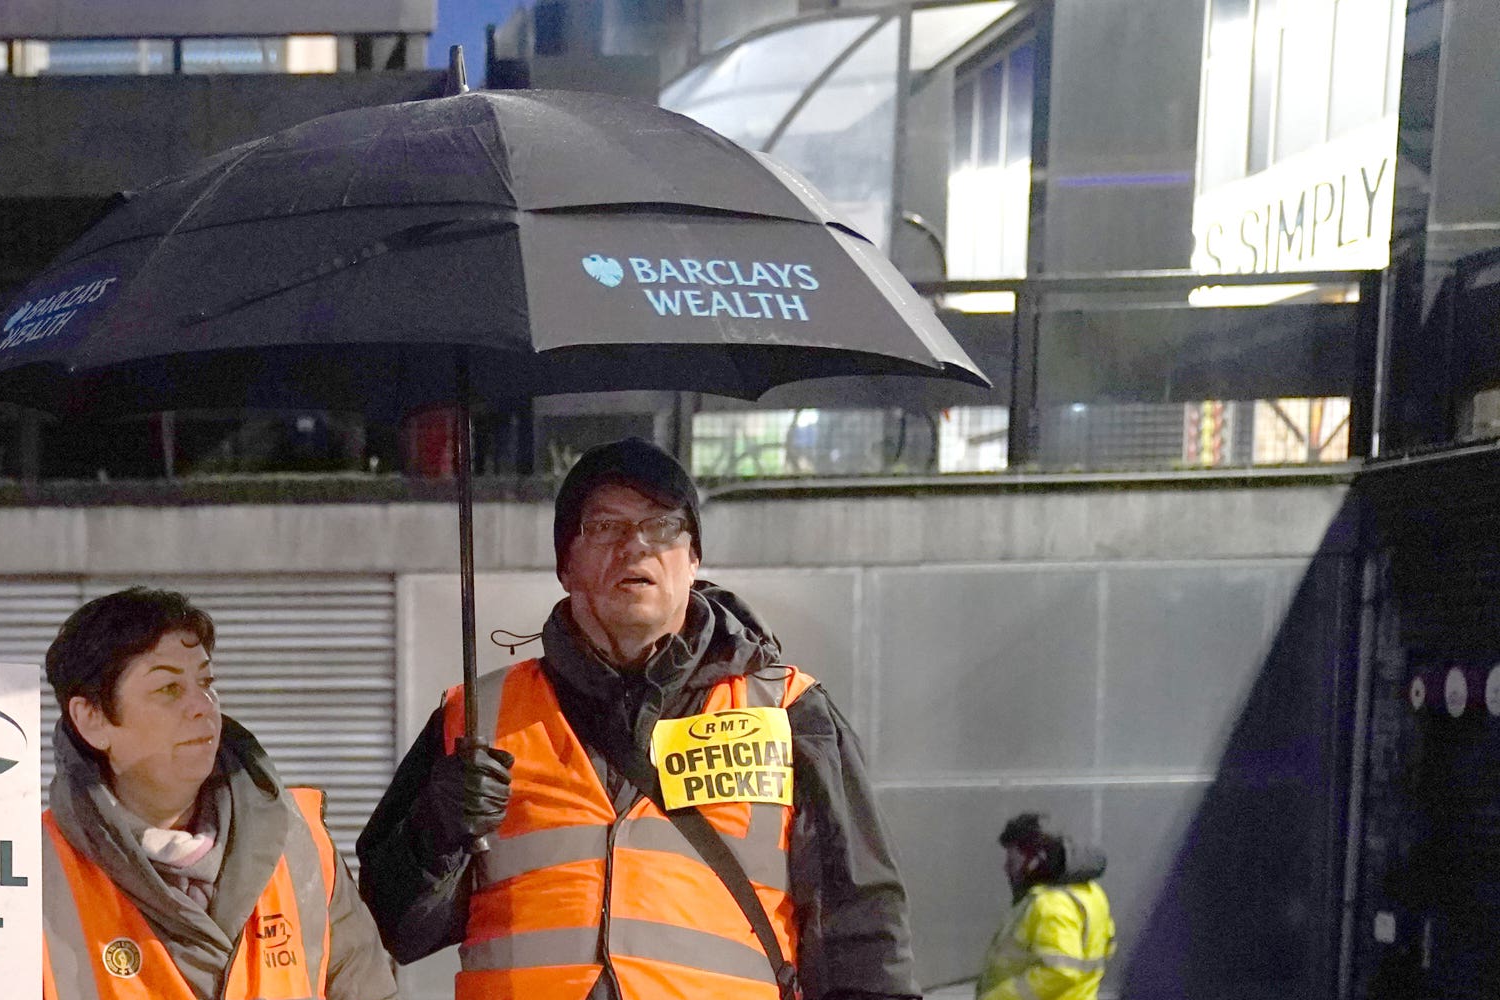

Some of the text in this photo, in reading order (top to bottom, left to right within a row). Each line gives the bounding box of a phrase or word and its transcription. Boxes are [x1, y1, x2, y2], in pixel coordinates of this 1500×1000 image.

[1240, 158, 1388, 273] SIMPLY
[628, 257, 820, 291] BARCLAYS
[20, 277, 117, 323] BARCLAYS
[643, 288, 810, 321] WEALTH
[705, 719, 749, 734] RMT
[684, 770, 787, 801] PICKET
